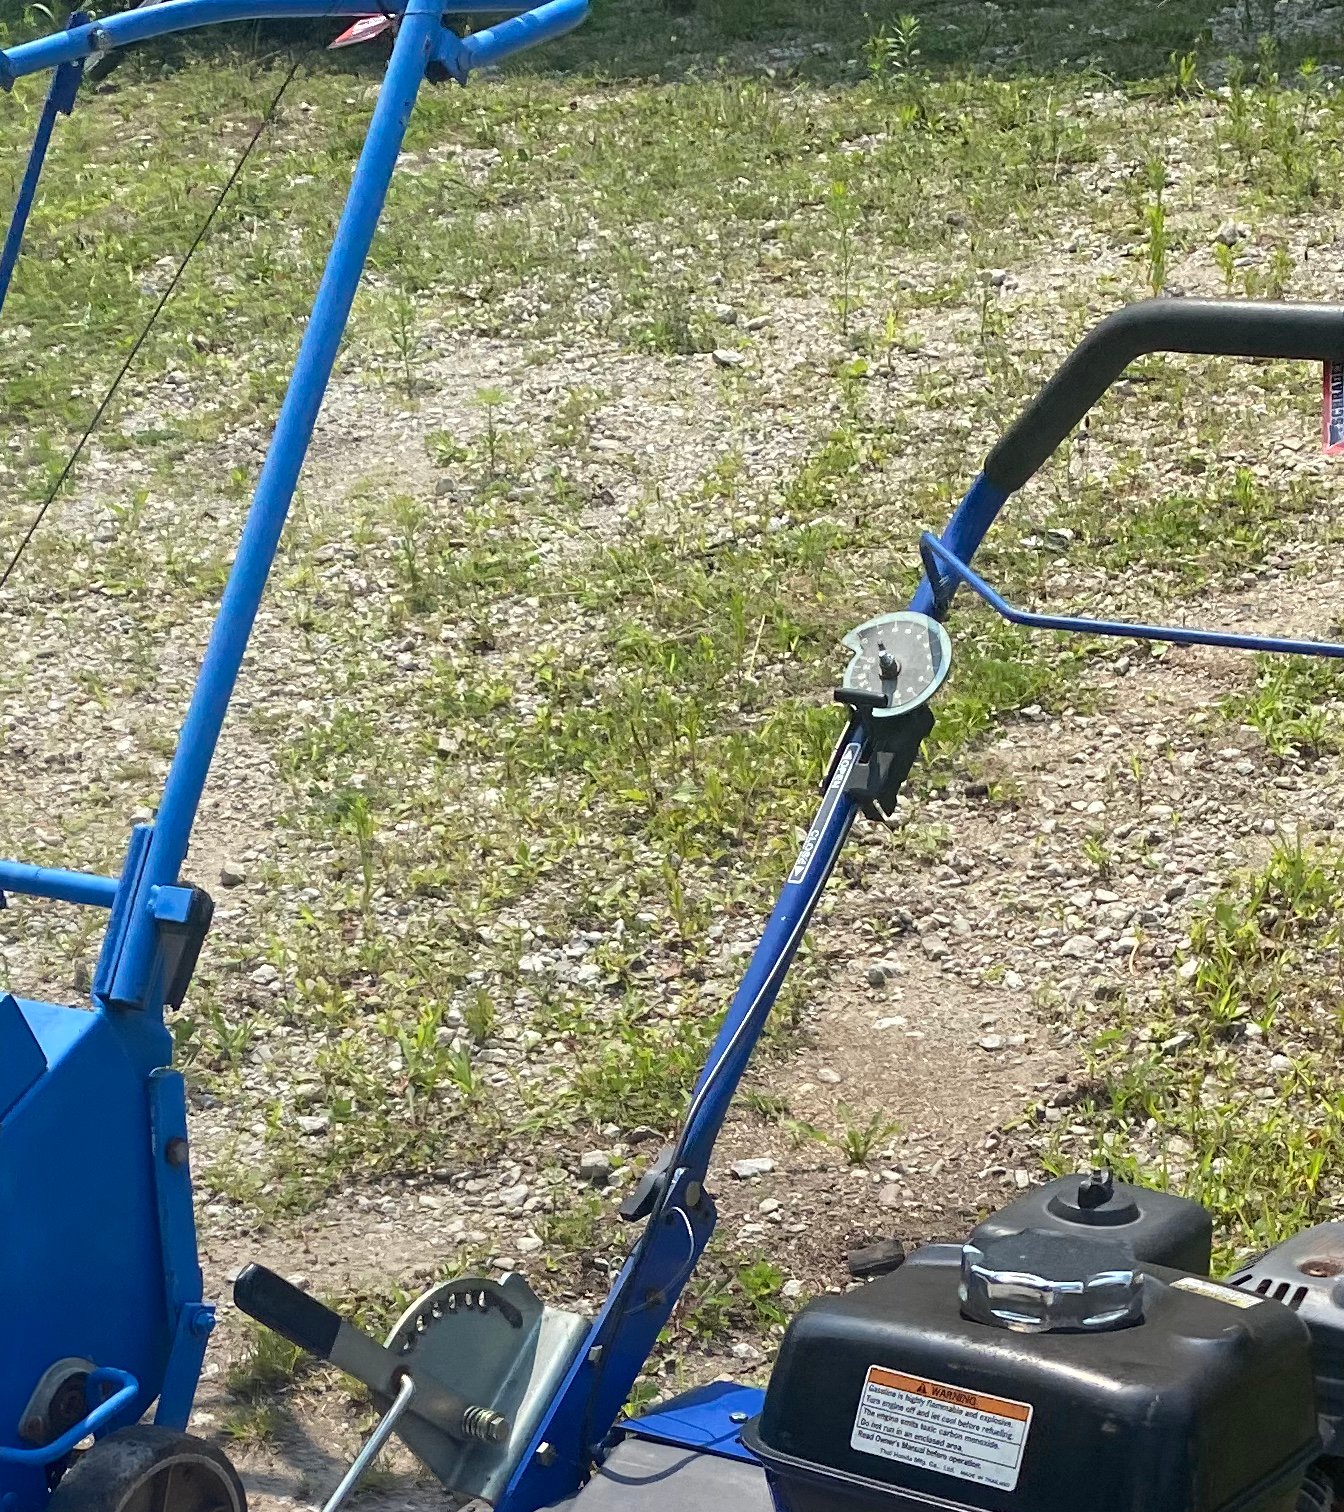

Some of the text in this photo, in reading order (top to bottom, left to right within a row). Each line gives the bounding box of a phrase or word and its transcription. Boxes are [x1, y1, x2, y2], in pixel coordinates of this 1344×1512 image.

[831, 759, 850, 789] OPEN
[796, 830, 819, 865] CLOSE
[868, 1383, 897, 1397] Gasoline
[904, 1393, 925, 1407] highly
[926, 1398, 964, 1415] flammable
[964, 1409, 978, 1418] and
[979, 1412, 1013, 1429] explosive.
[930, 1385, 977, 1406] WARNING
[860, 1417, 870, 1426] Do
[870, 1421, 882, 1430] not
[882, 1425, 895, 1433] run
[903, 1430, 912, 1438] an
[913, 1432, 945, 1446] enclosed
[945, 1441, 963, 1451] area.
[862, 1408, 875, 1416] The
[876, 1411, 899, 1424] engine
[920, 1422, 937, 1433] toxic
[938, 1426, 963, 1440] carbon
[963, 1433, 1000, 1450] monoxide.
[865, 1394, 1014, 1440] Turn engine off and let cool before refueling.
[857, 1429, 982, 1470] Read Owner's Manual before operation.
